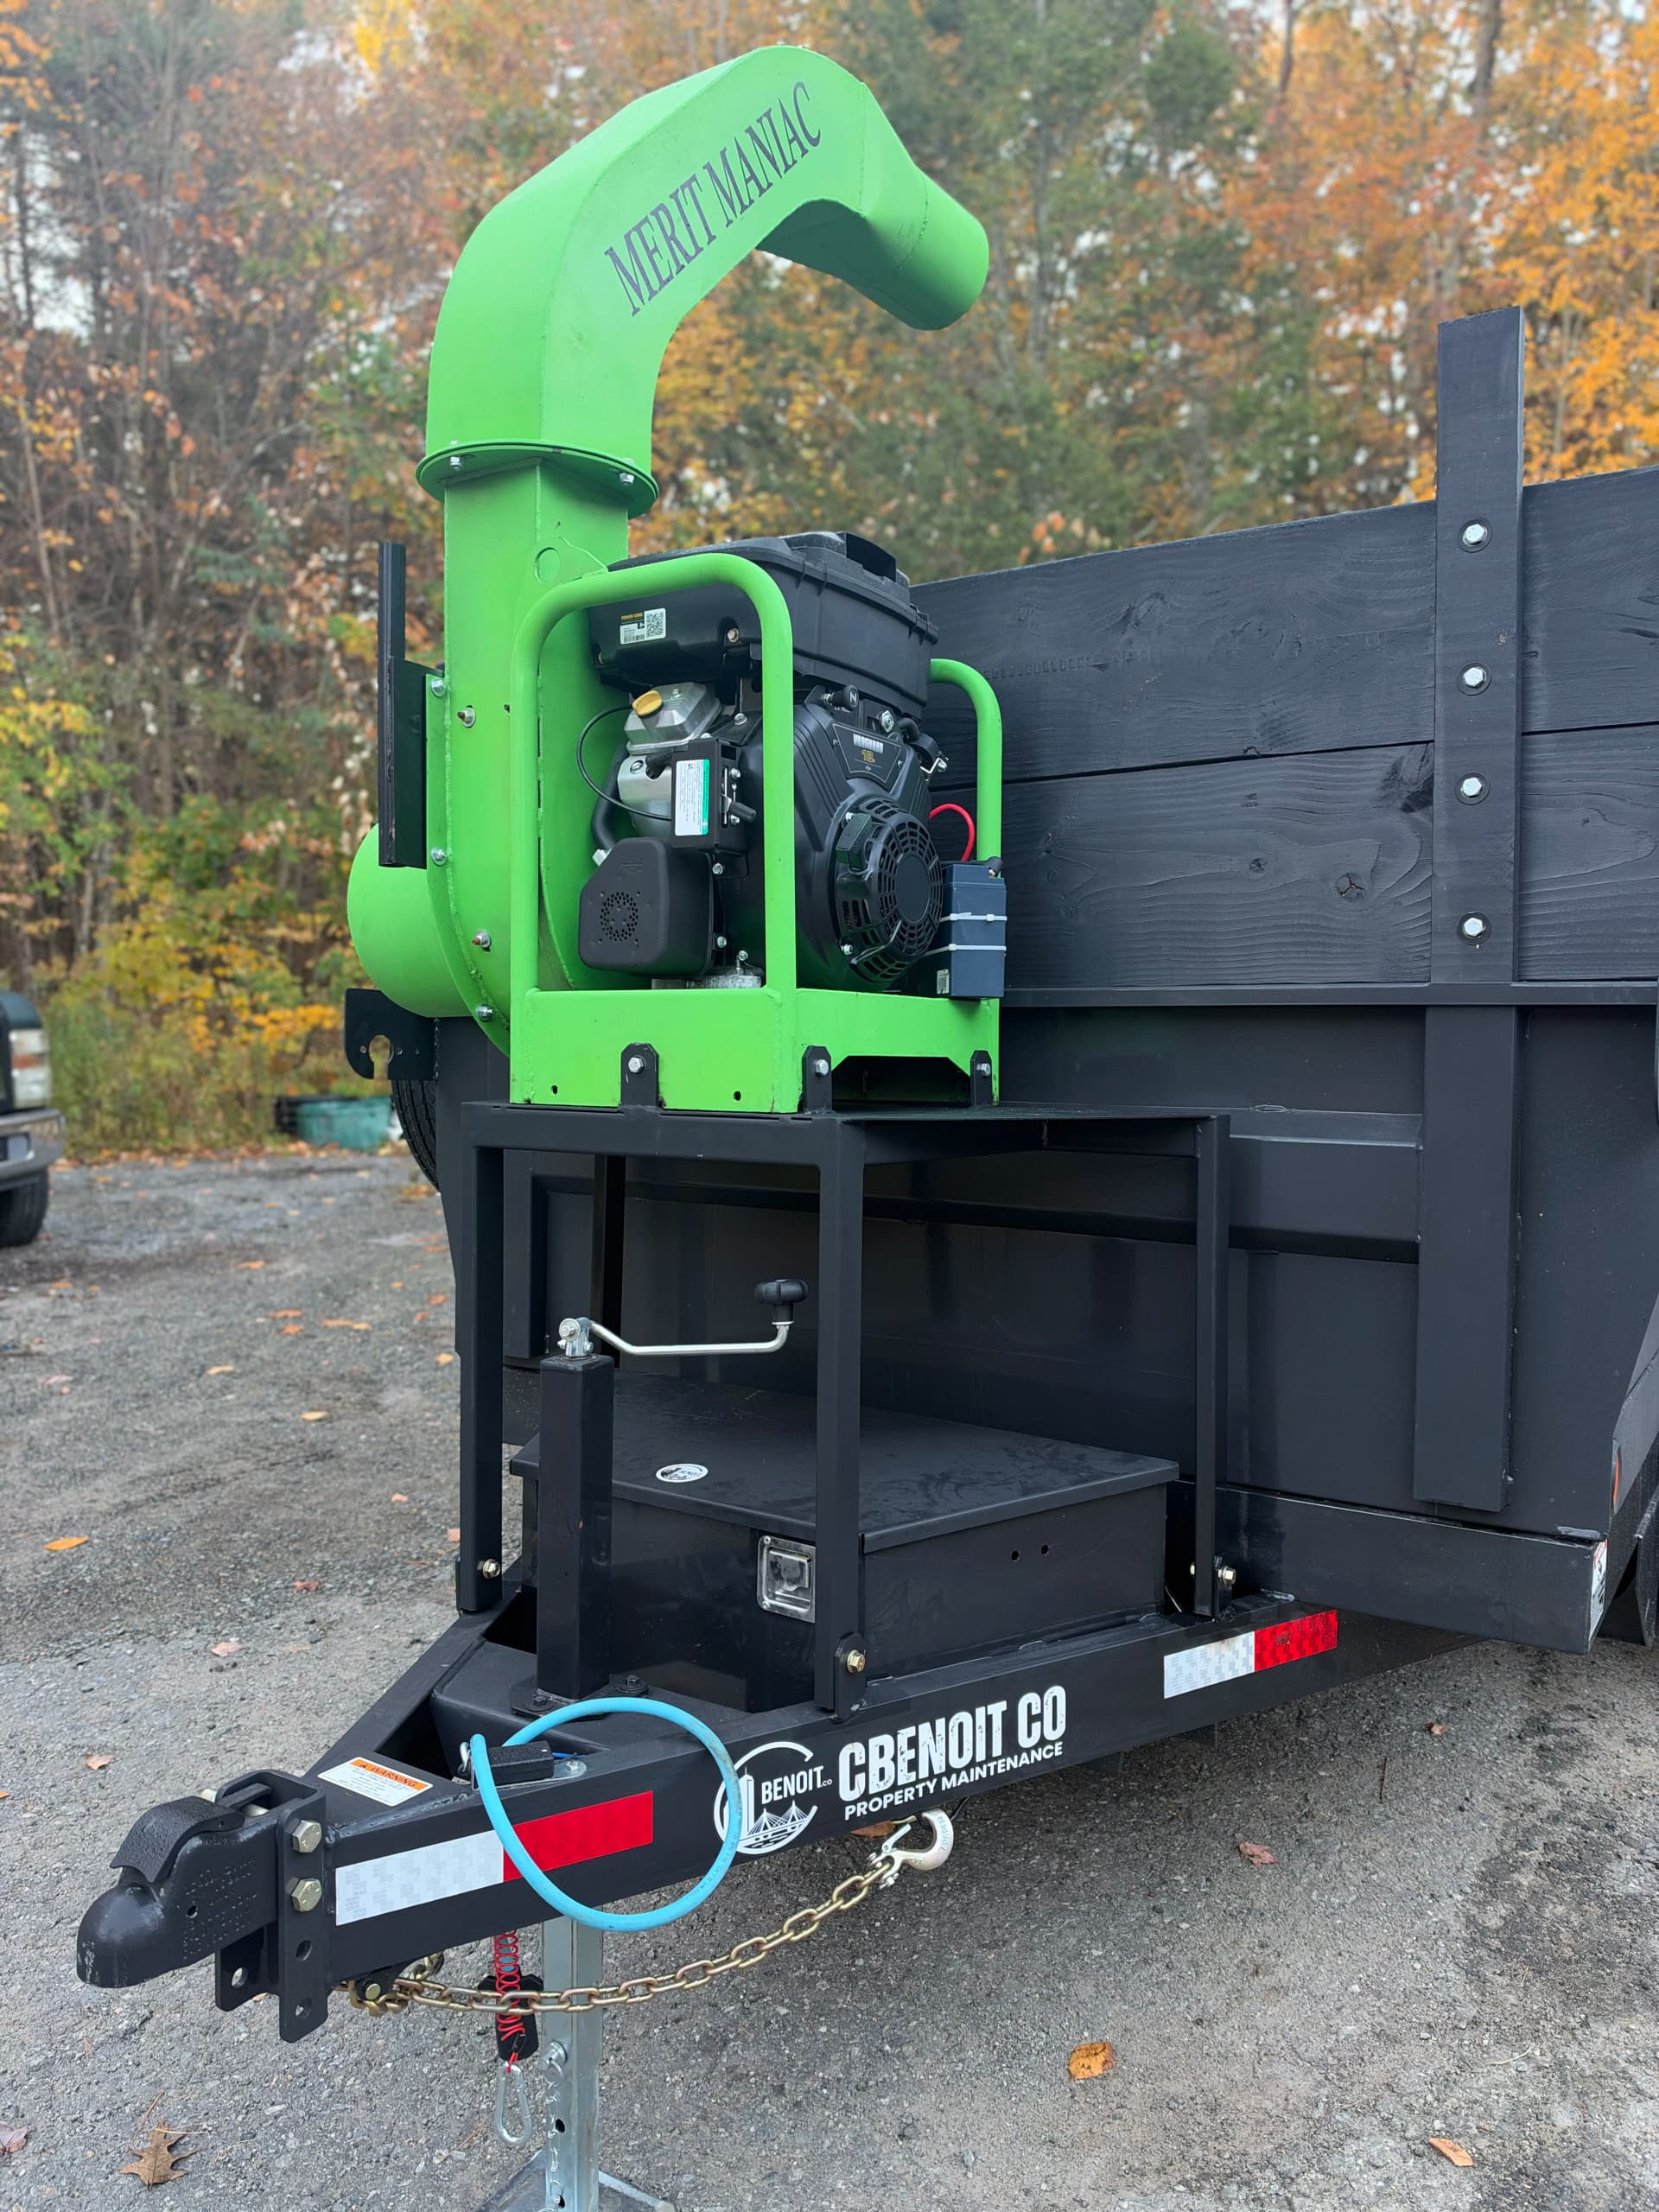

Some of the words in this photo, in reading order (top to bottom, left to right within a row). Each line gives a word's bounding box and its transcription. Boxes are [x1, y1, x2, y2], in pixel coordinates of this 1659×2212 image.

[604, 173, 717, 318] MERIT
[702, 81, 822, 228] MANIAC
[370, 1766, 416, 1788] WARNING
[837, 1700, 1008, 1802] CBENOIT
[1017, 1685, 1066, 1748] CO
[844, 1778, 938, 1821] PROPERTY
[941, 1741, 1063, 1791] MAINTENANCE
